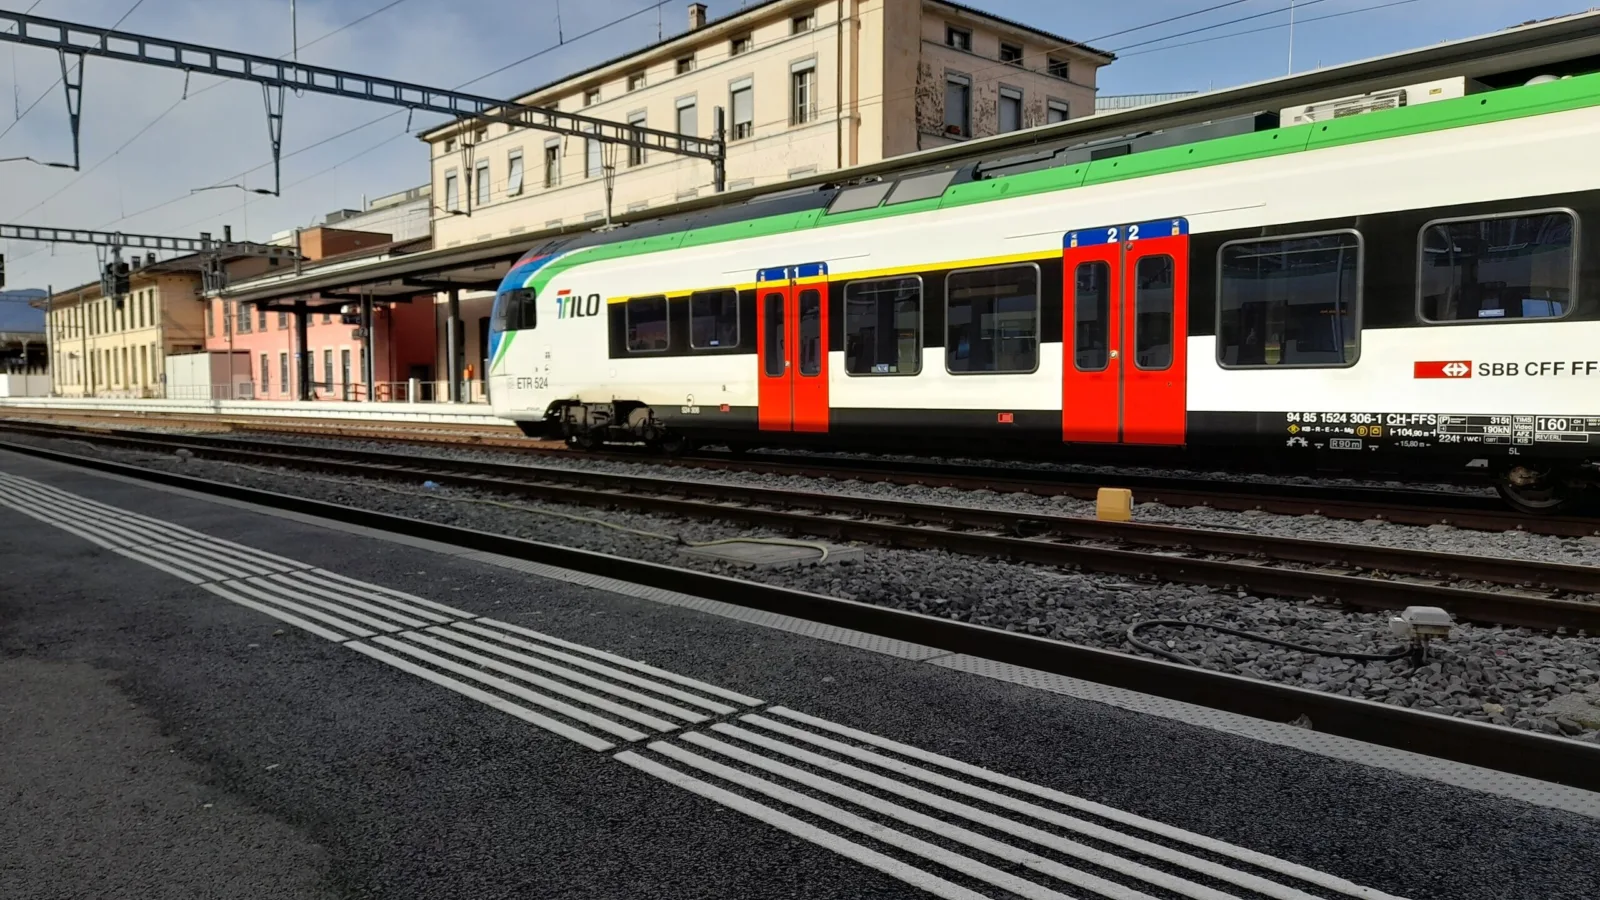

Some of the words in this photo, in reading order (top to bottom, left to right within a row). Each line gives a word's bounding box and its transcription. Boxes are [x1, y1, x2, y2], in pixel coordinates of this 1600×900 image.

[1107, 227, 1118, 243] 2
[1128, 225, 1139, 240] 2
[783, 268, 788, 279] 1
[794, 266, 799, 278] 1
[556, 289, 600, 319] TILO
[1478, 362, 1519, 377] SBB
[1525, 361, 1565, 376] CFF
[1571, 361, 1600, 376] FF
[517, 377, 532, 389] ETR
[534, 377, 549, 389] 524
[1287, 413, 1300, 422] 94
[1303, 413, 1317, 423] 85
[1321, 413, 1347, 423] 1524
[1350, 413, 1382, 424] 306-1
[1386, 414, 1437, 426] CH-FFS
[1538, 418, 1567, 431] 160
[1438, 434, 1460, 443] 224t
